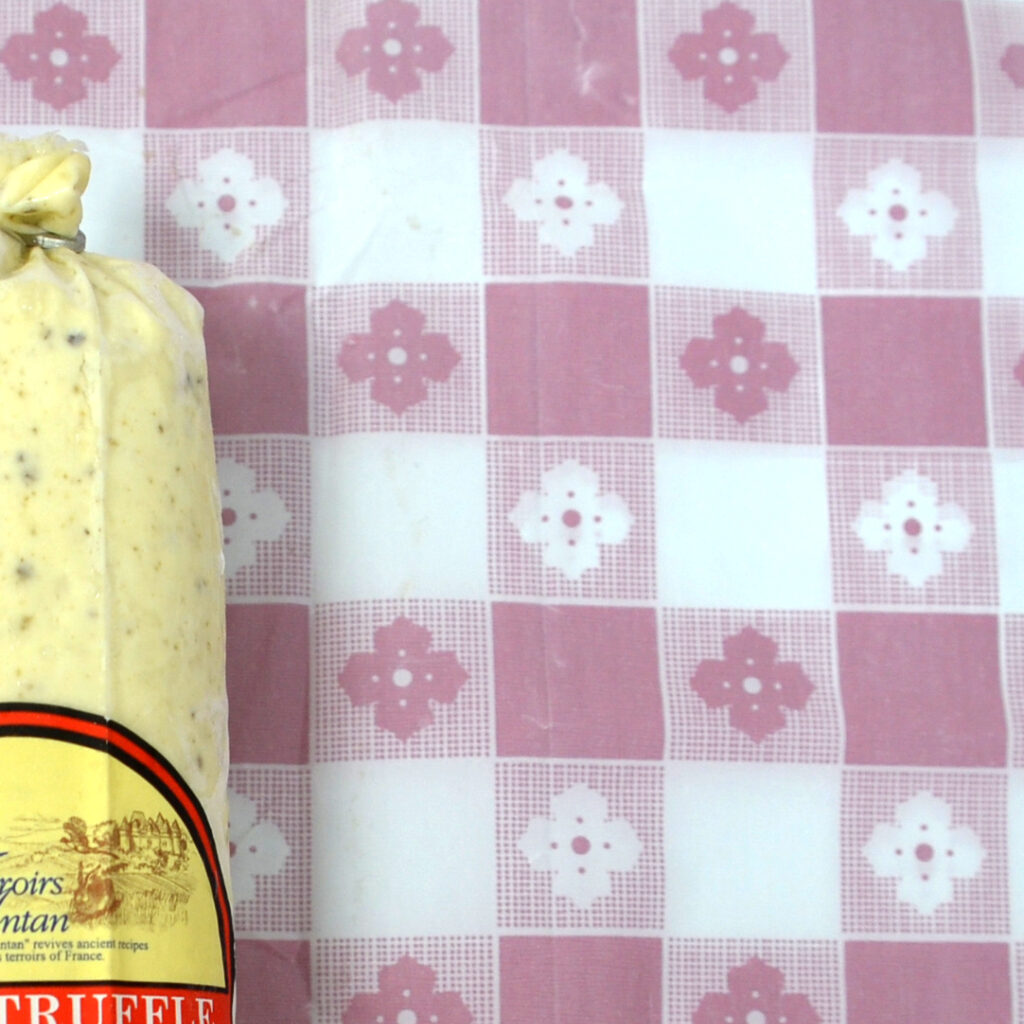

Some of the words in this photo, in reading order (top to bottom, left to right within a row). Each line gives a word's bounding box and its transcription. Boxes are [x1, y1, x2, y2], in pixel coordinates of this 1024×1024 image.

[33, 940, 73, 949] revives
[77, 939, 116, 949] ancient
[118, 940, 149, 952] recipes
[5, 952, 48, 962] terroirs
[50, 951, 62, 961] of
